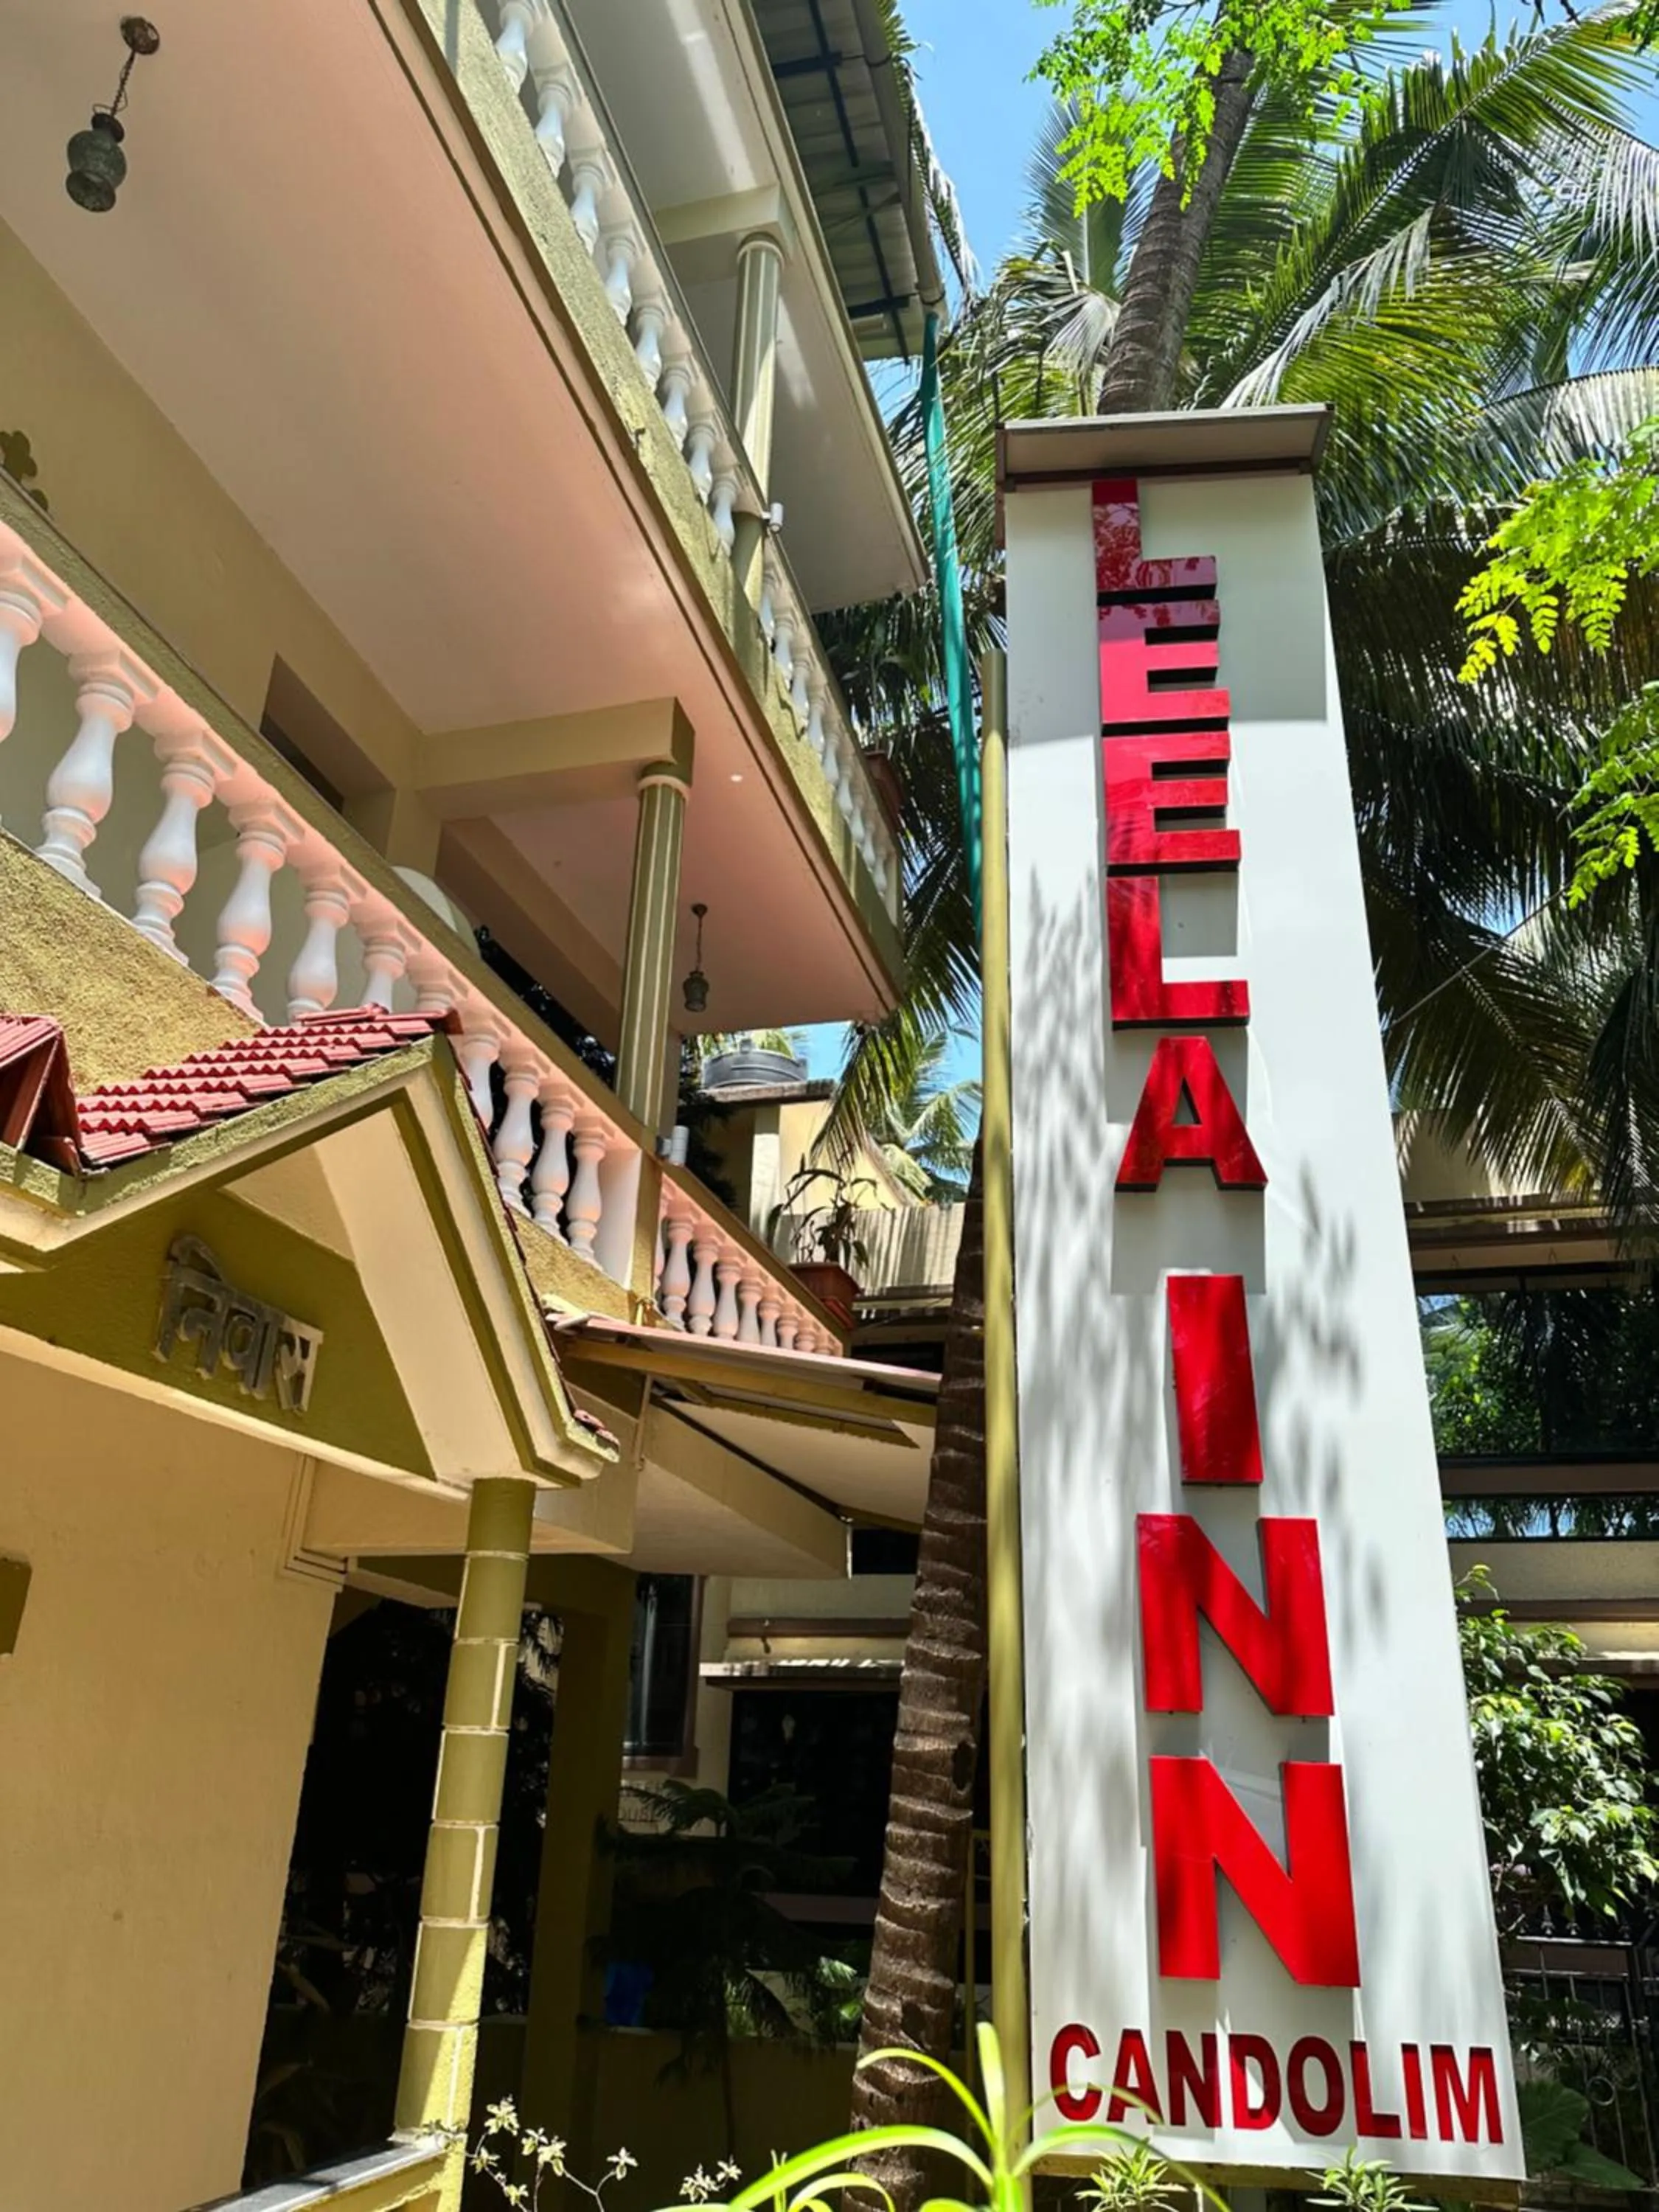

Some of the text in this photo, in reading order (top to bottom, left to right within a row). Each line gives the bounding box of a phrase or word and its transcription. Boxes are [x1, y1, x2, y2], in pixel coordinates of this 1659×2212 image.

[1092, 479, 1360, 1988] LEELA INN
[154, 1234, 324, 1413] निवास
[1049, 2023, 1504, 2145] CANDOLIM
